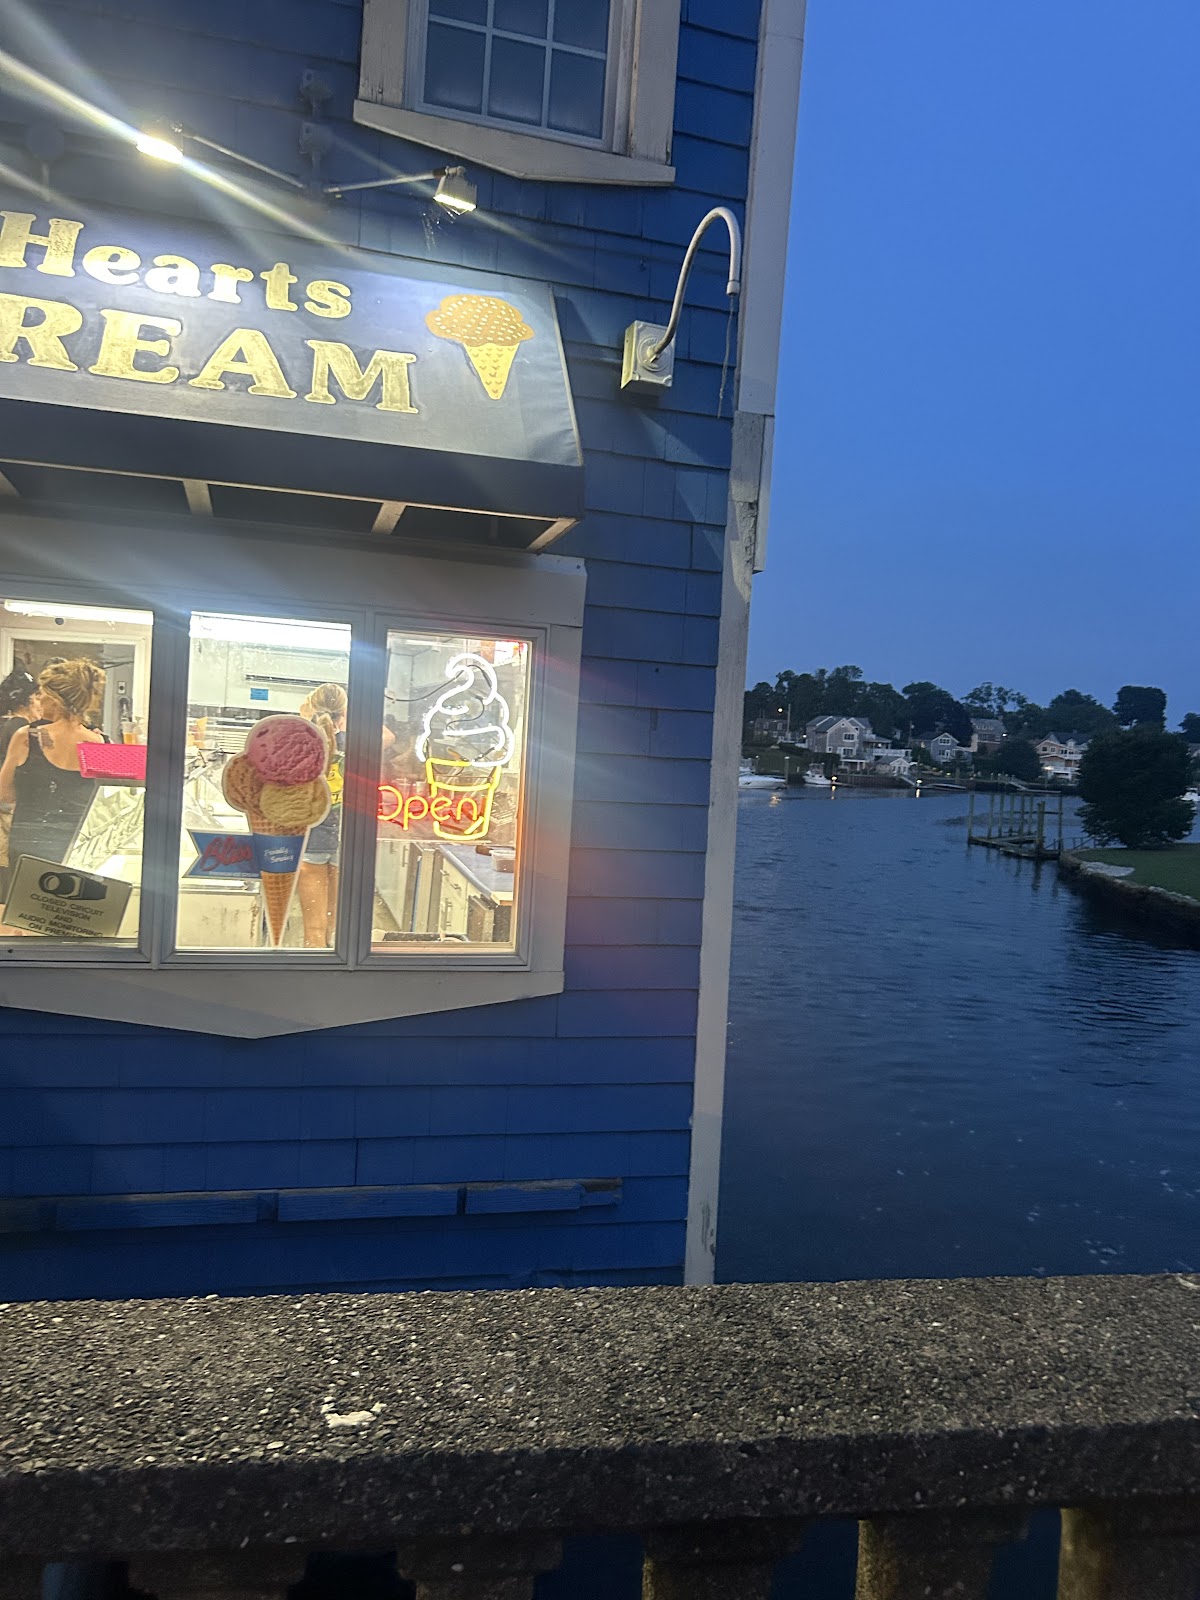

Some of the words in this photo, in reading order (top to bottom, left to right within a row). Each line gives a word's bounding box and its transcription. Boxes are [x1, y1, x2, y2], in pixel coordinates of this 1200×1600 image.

[0, 211, 351, 318] Hearts
[0, 292, 418, 413] REAM
[30, 893, 67, 908] CLOSED
[70, 903, 104, 918] CIRCUIT
[41, 903, 91, 921] TELEVISION
[18, 912, 46, 924] AUDIO
[49, 920, 104, 937] MONITORING
[28, 922, 42, 931] ON
[55, 914, 73, 924] AND
